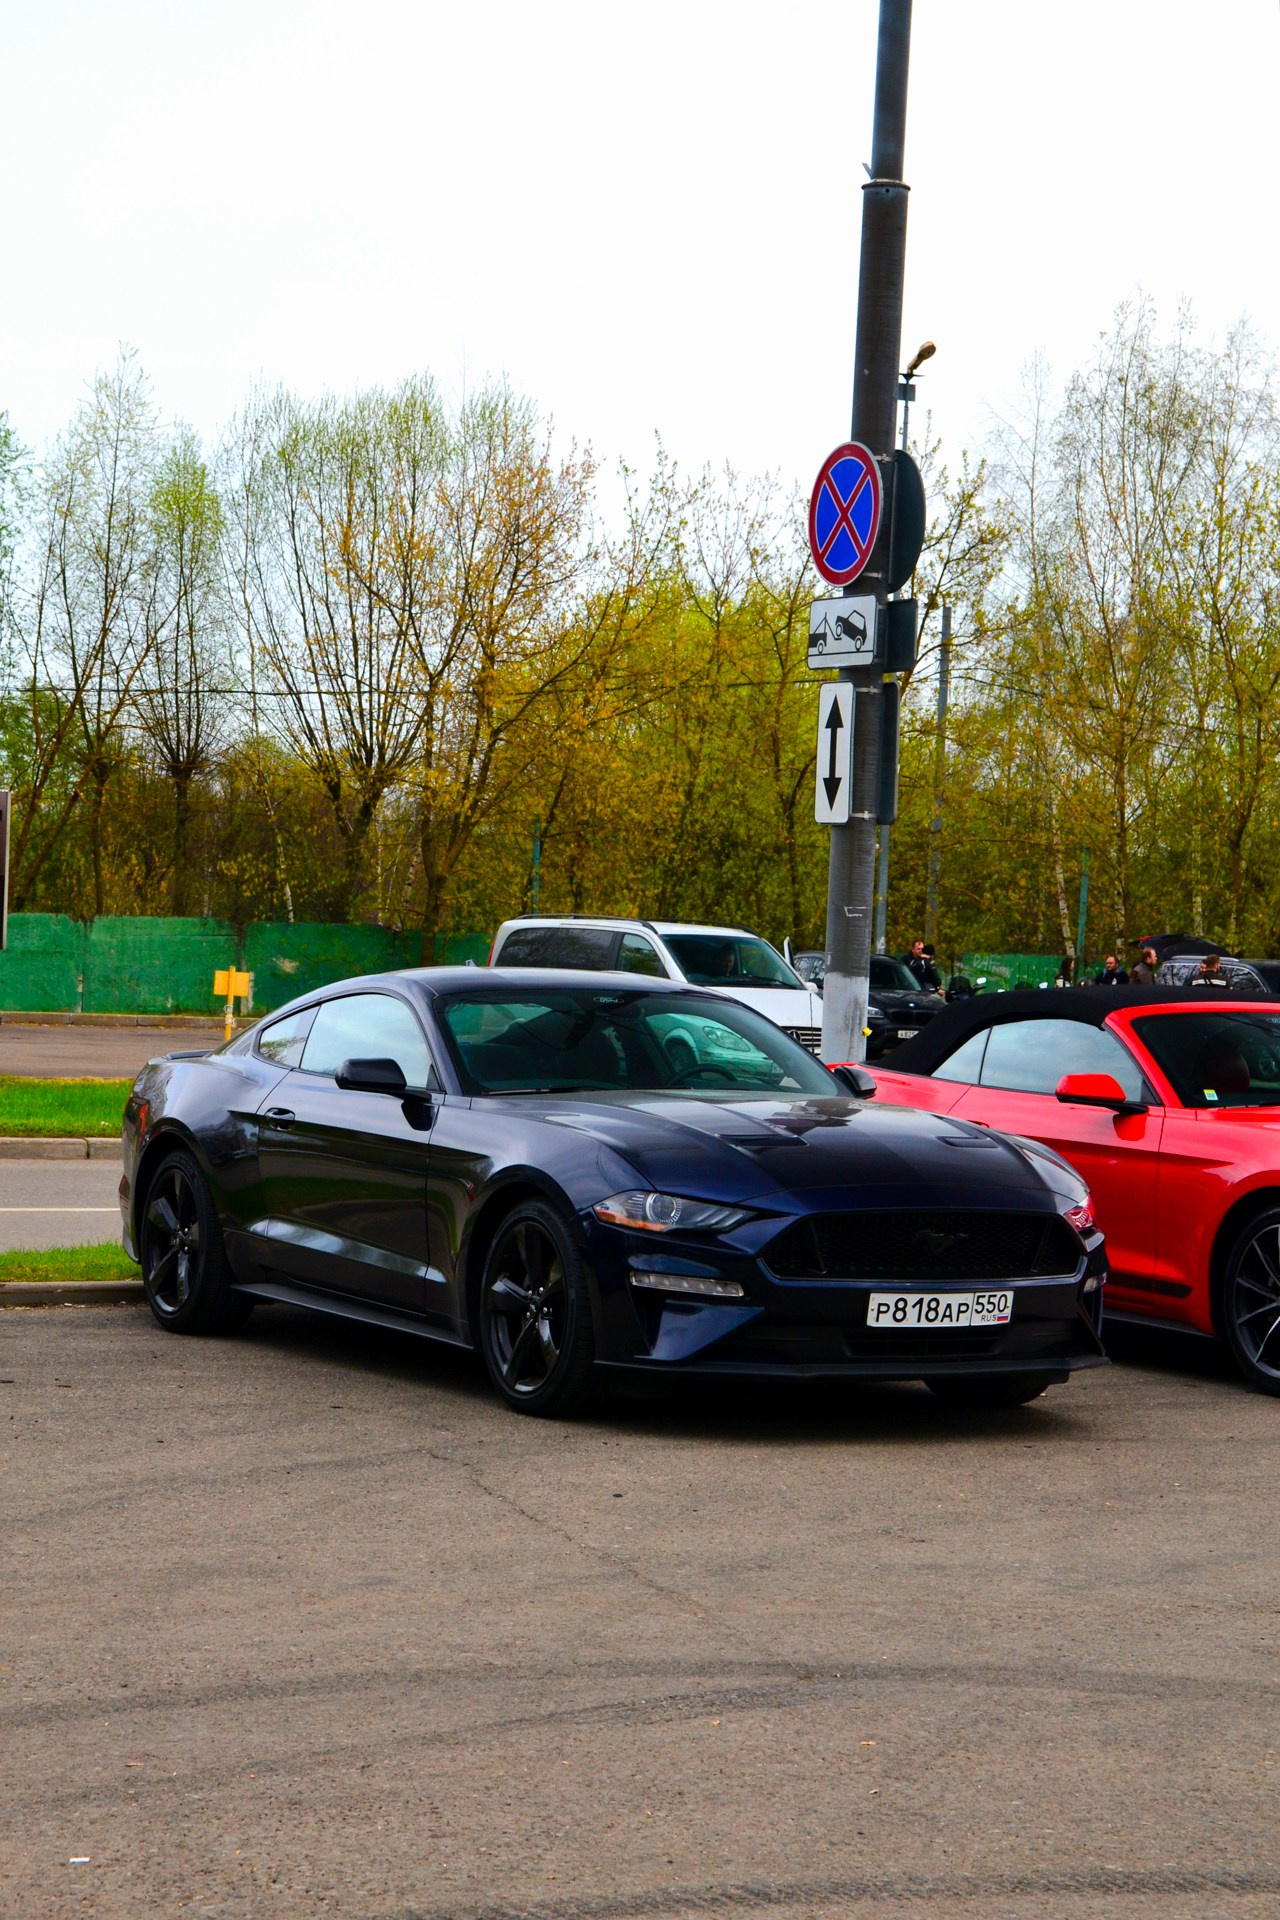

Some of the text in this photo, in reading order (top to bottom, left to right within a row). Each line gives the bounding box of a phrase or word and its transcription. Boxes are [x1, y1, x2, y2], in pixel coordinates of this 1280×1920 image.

[875, 1294, 1008, 1323] P818AP 550
[980, 1314, 997, 1322] RUS
